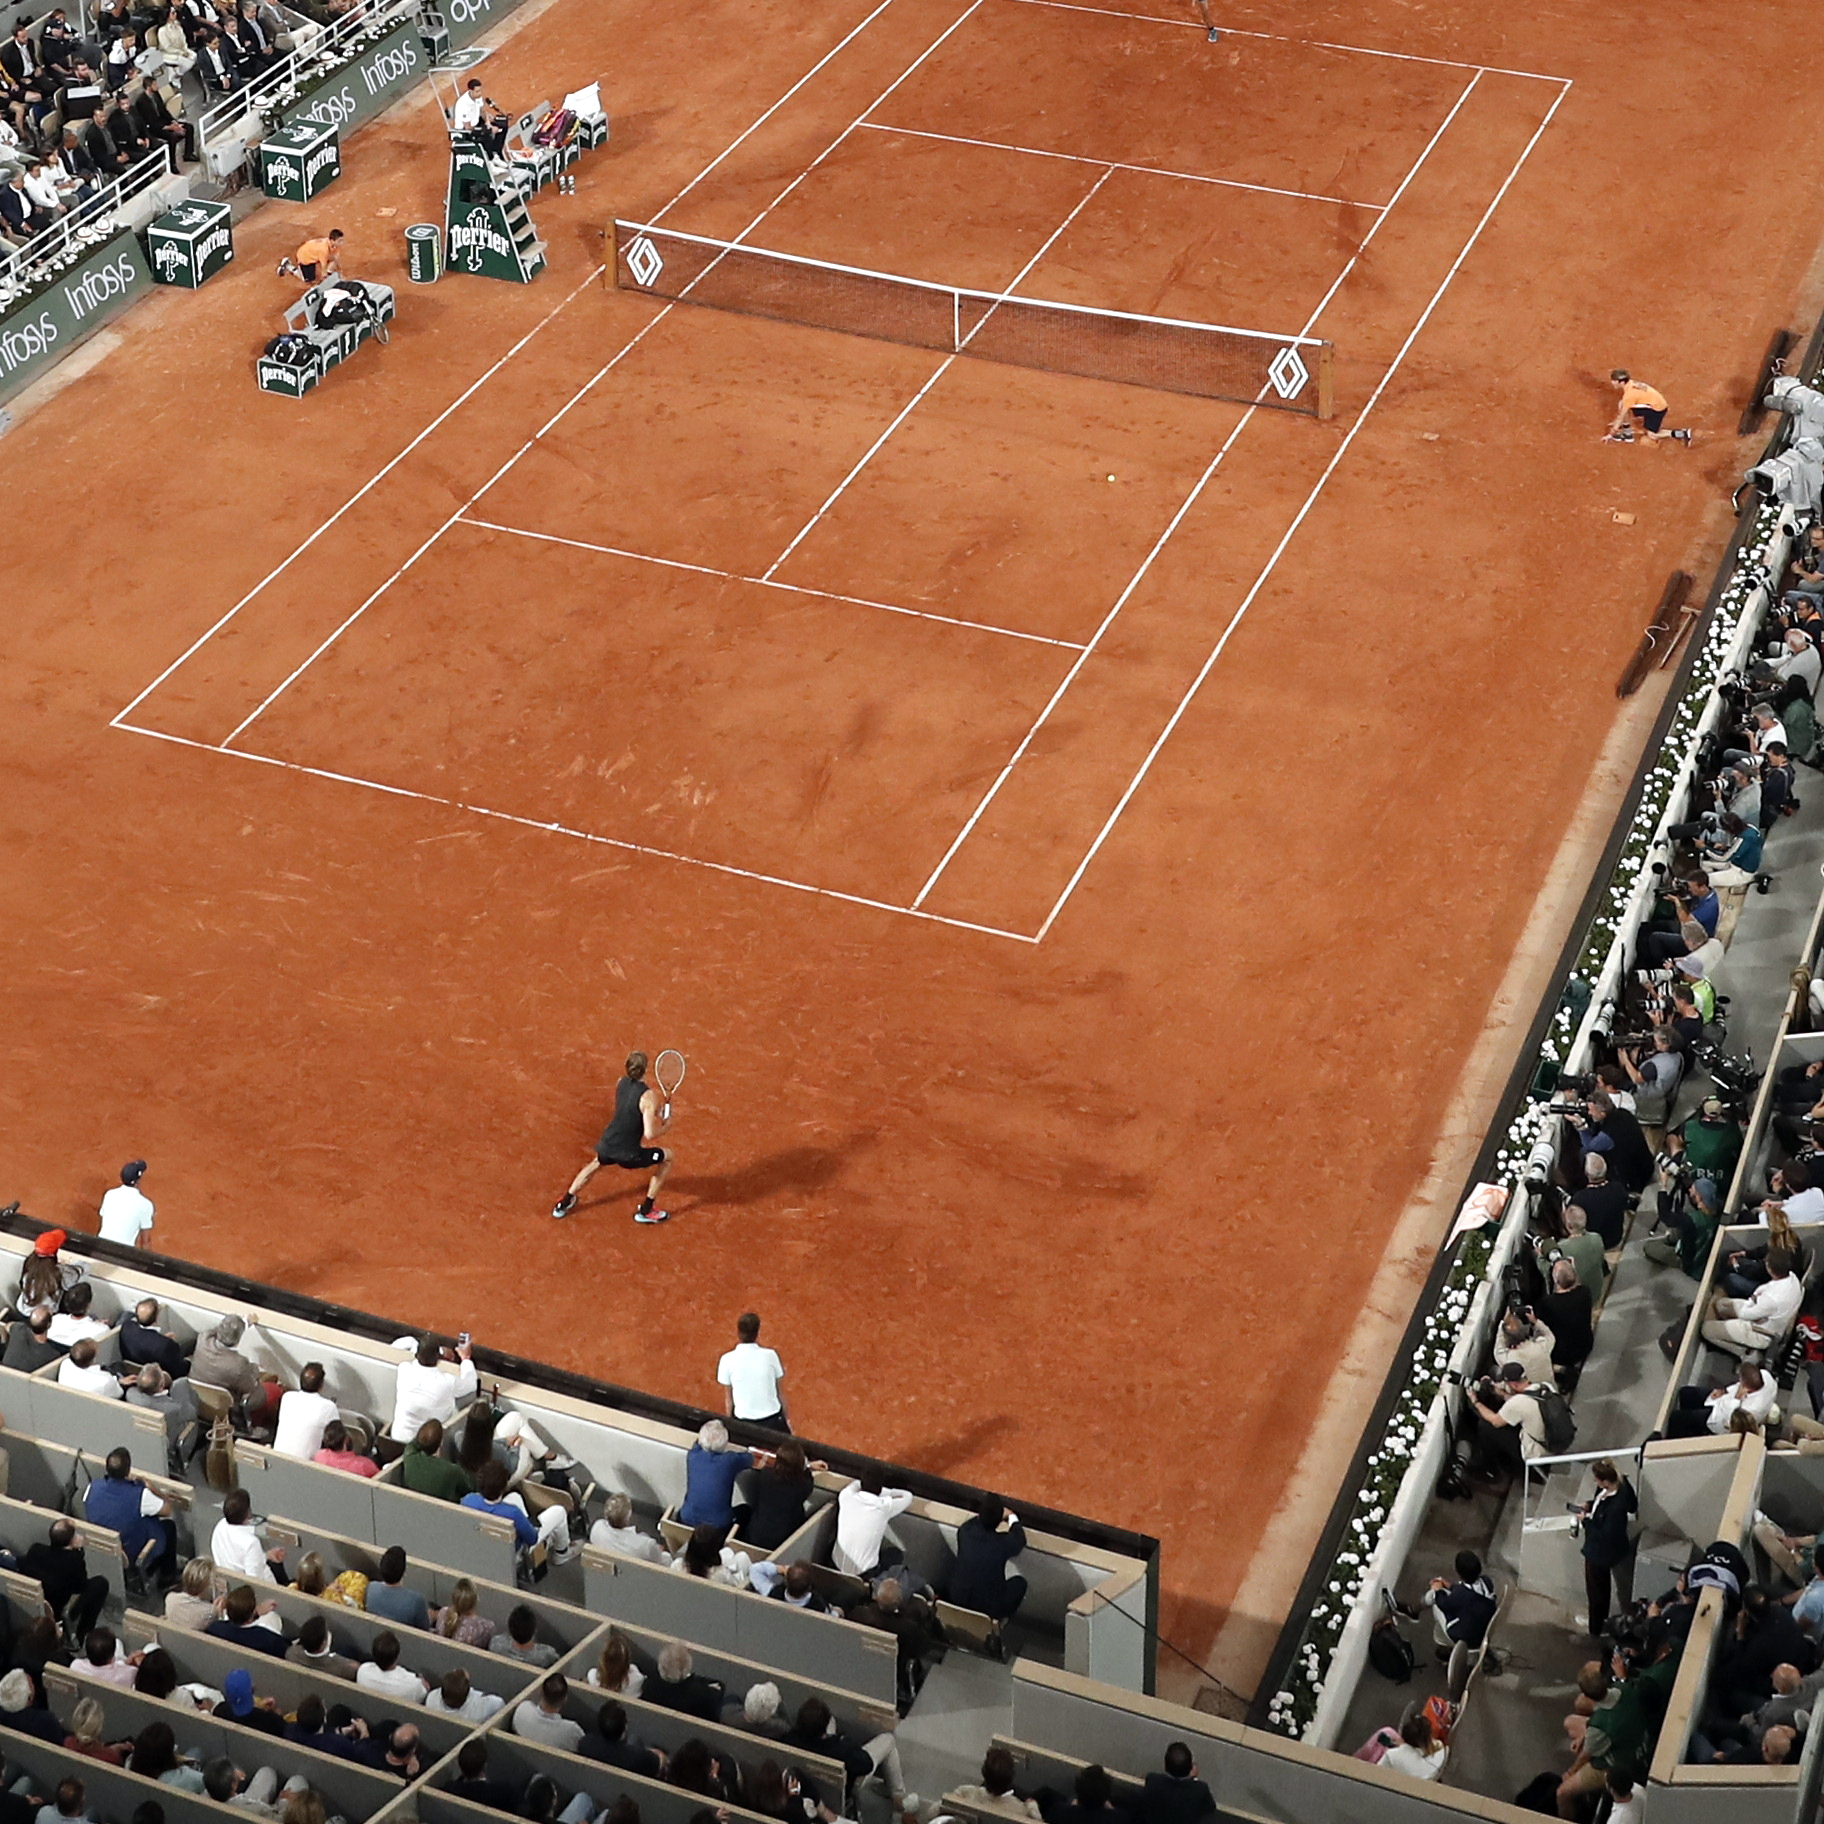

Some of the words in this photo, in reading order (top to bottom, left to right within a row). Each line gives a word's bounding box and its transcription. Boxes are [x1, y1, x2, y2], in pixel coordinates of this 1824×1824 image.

[360, 39, 417, 96] Infosys
[63, 252, 136, 322] Infosys
[410, 242, 422, 280] Wilson
